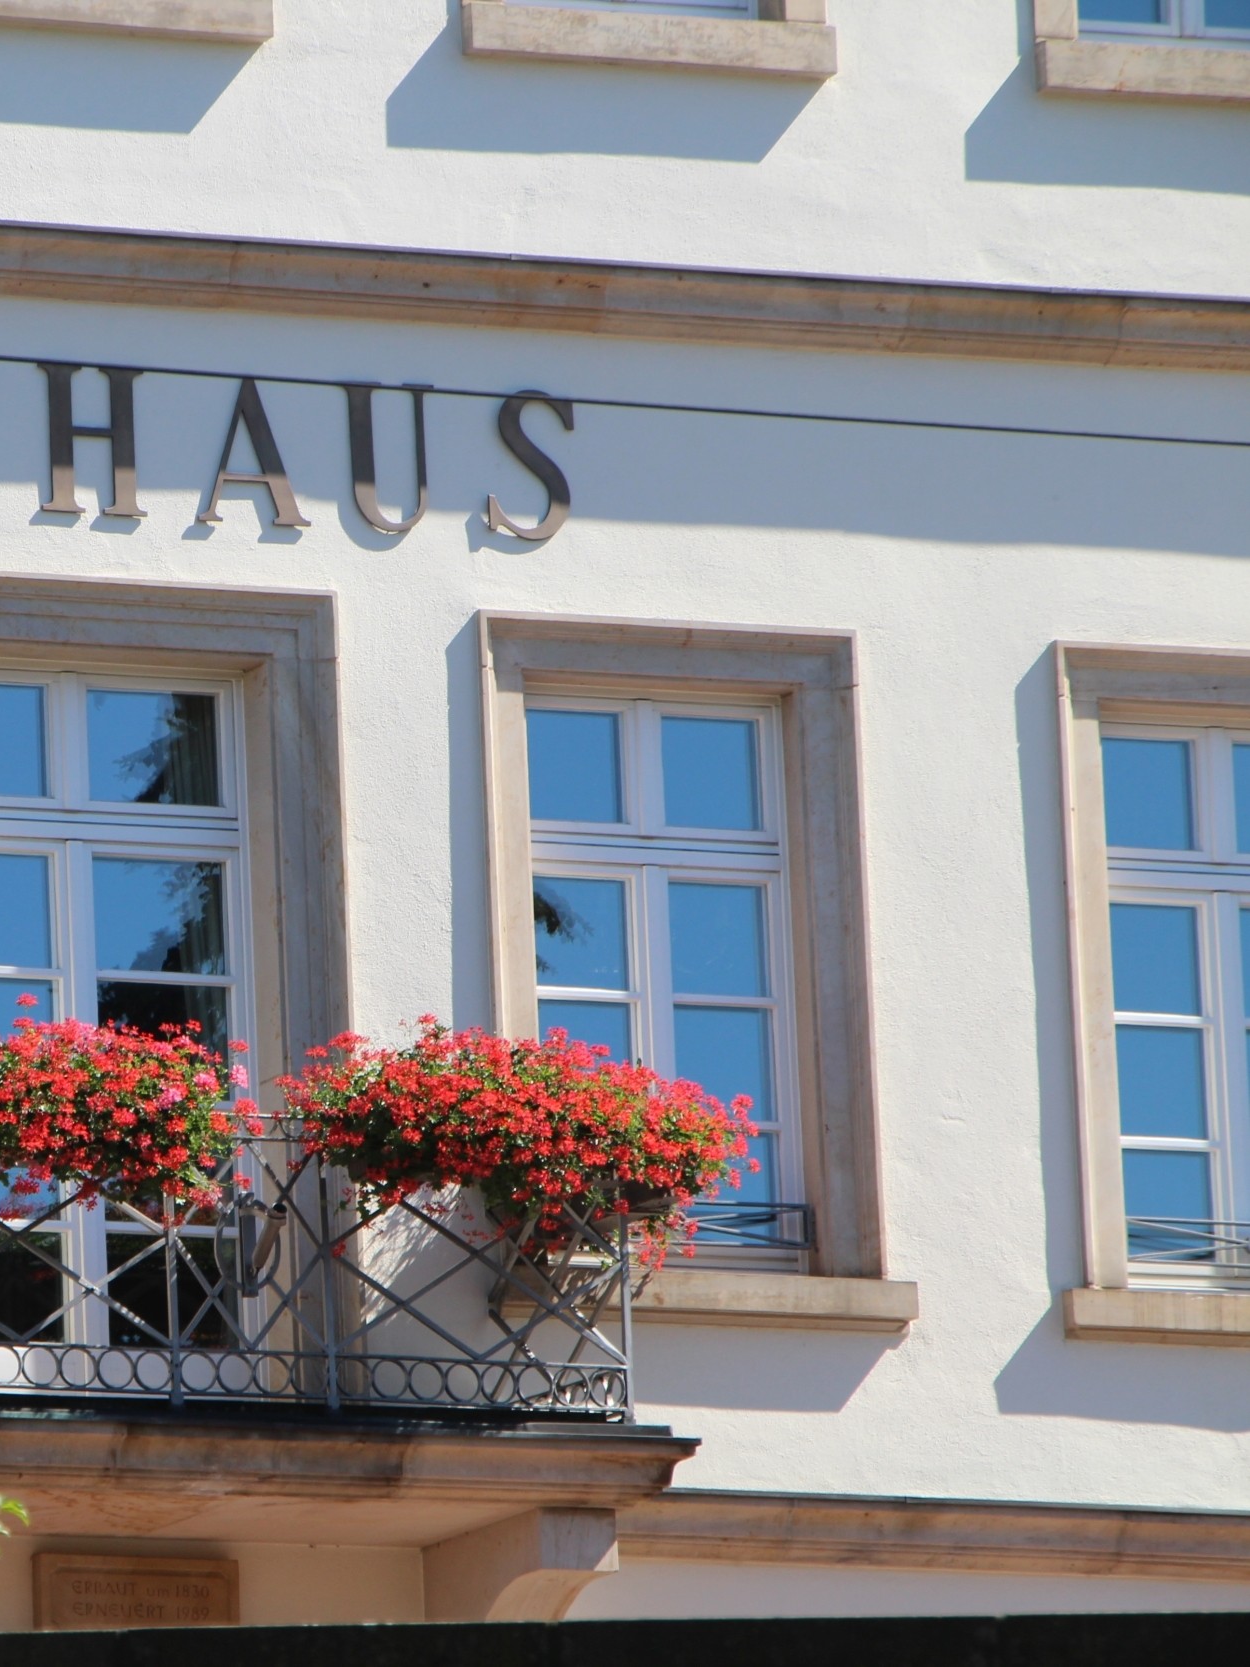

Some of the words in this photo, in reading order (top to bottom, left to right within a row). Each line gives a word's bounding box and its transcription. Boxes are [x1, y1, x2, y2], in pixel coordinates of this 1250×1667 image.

[145, 1586, 170, 1597] um
[175, 1584, 210, 1599] 1830
[72, 1601, 165, 1619] ERNEUERT
[175, 1606, 210, 1621] 1989
